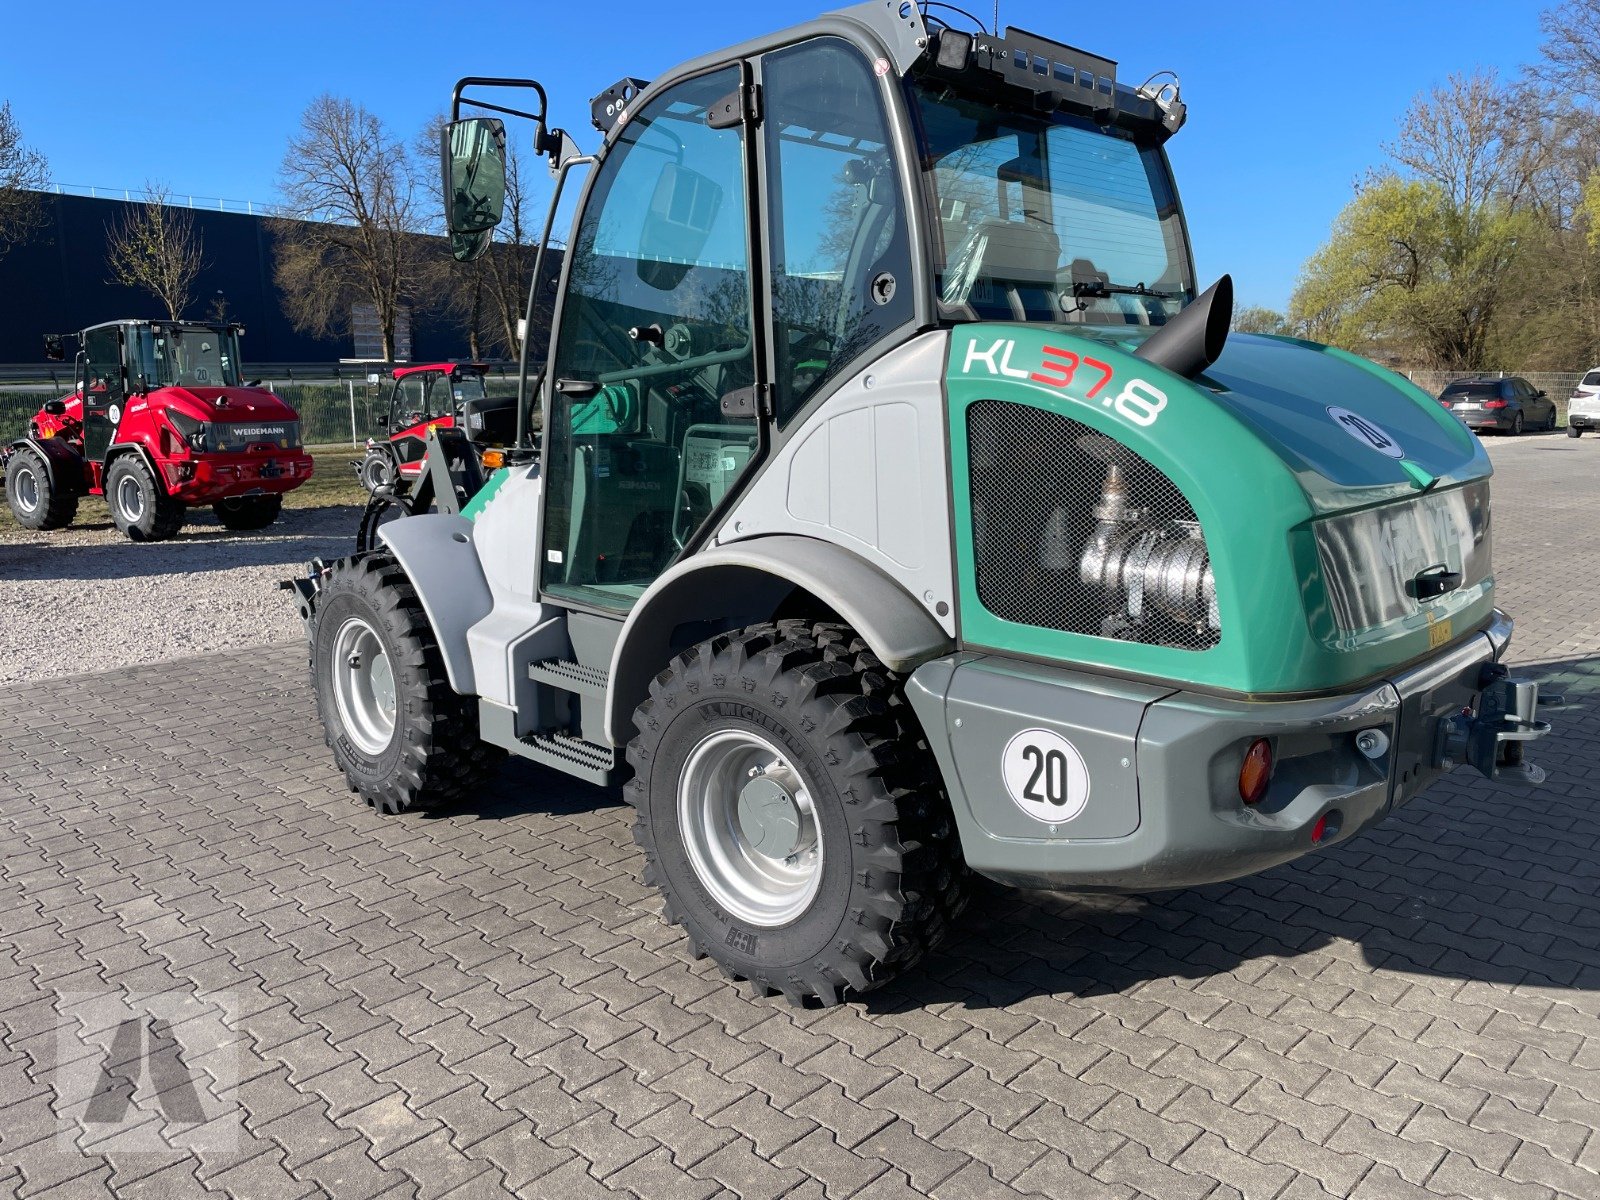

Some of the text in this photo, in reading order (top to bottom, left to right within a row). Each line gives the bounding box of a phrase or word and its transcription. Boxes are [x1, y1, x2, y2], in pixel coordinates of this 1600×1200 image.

[196, 368, 207, 380] 20
[961, 338, 1169, 427] KL37.8
[233, 427, 285, 436] WEIDEMANN
[1338, 414, 1392, 449] 20
[720, 701, 804, 758] MICHELIN
[1022, 744, 1068, 807] 20
